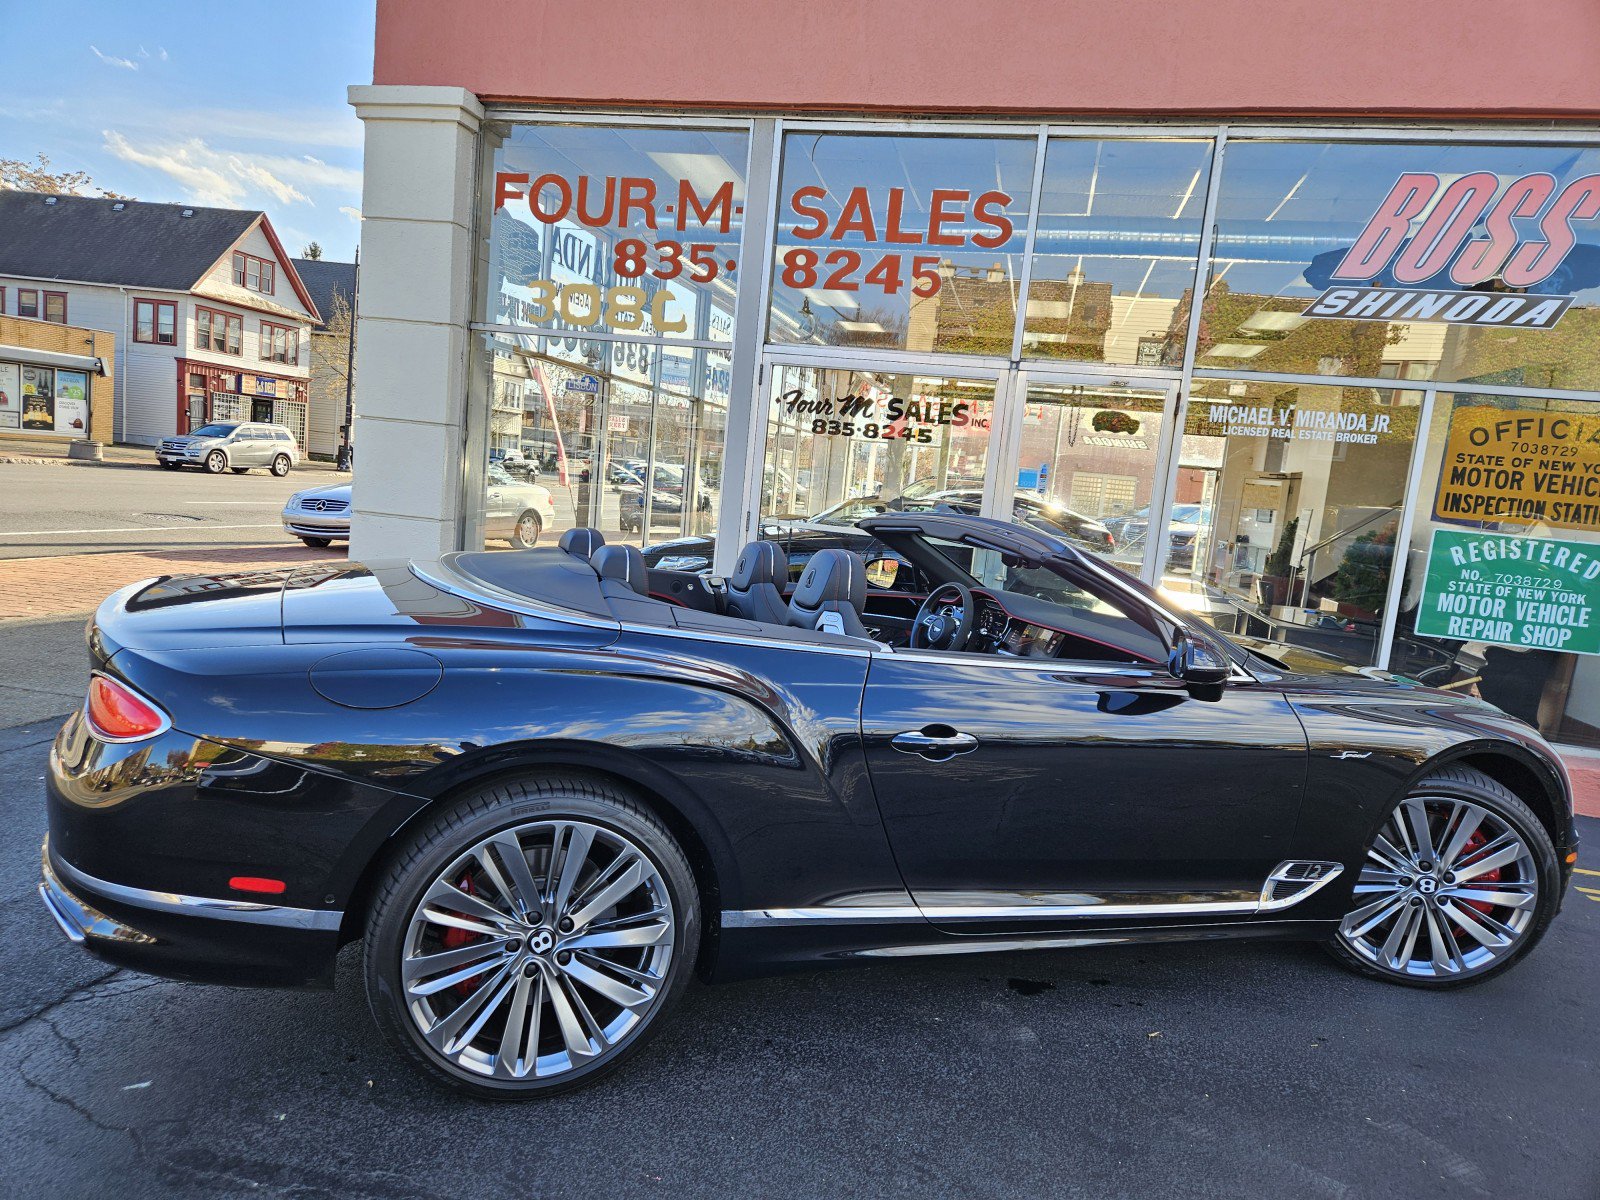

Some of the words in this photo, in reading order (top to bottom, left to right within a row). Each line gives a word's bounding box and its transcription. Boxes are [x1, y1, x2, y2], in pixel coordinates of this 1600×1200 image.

[791, 186, 1013, 249] SALES
[1330, 171, 1600, 288] BOSS
[781, 249, 942, 298] 8245
[1312, 290, 1563, 325] SHINODA
[836, 393, 874, 419] M
[886, 397, 969, 427] SALES
[1209, 405, 1275, 426] MICHAEL
[1295, 410, 1367, 432] MIRANDA
[1370, 414, 1393, 434] JR.
[1222, 425, 1269, 437] LICENSED
[1271, 428, 1296, 439] REAL
[1299, 430, 1334, 441] ESTATE
[1336, 433, 1378, 445] BROKER
[1511, 441, 1578, 457] 7038729
[1456, 453, 1505, 467] STATE
[1511, 457, 1533, 468] OF
[1538, 460, 1576, 472] NEW
[1450, 466, 1525, 490] MOTOR
[1533, 472, 1600, 497] VEHIC
[1443, 492, 1546, 520] INSPECTION
[1550, 502, 1600, 527] STATI
[1450, 539, 1600, 580] REGISTERED
[1448, 581, 1492, 595] STATE
[1495, 585, 1512, 597] OF
[1516, 587, 1547, 600] NEW
[1551, 590, 1587, 605] YORK
[1461, 569, 1484, 581] NO.
[1495, 573, 1563, 590] 7038729
[1437, 592, 1506, 618] MOTOR
[1516, 601, 1592, 628] VEHICLE
[1447, 616, 1513, 642] REPAIR
[1520, 624, 1572, 648] SHOP
